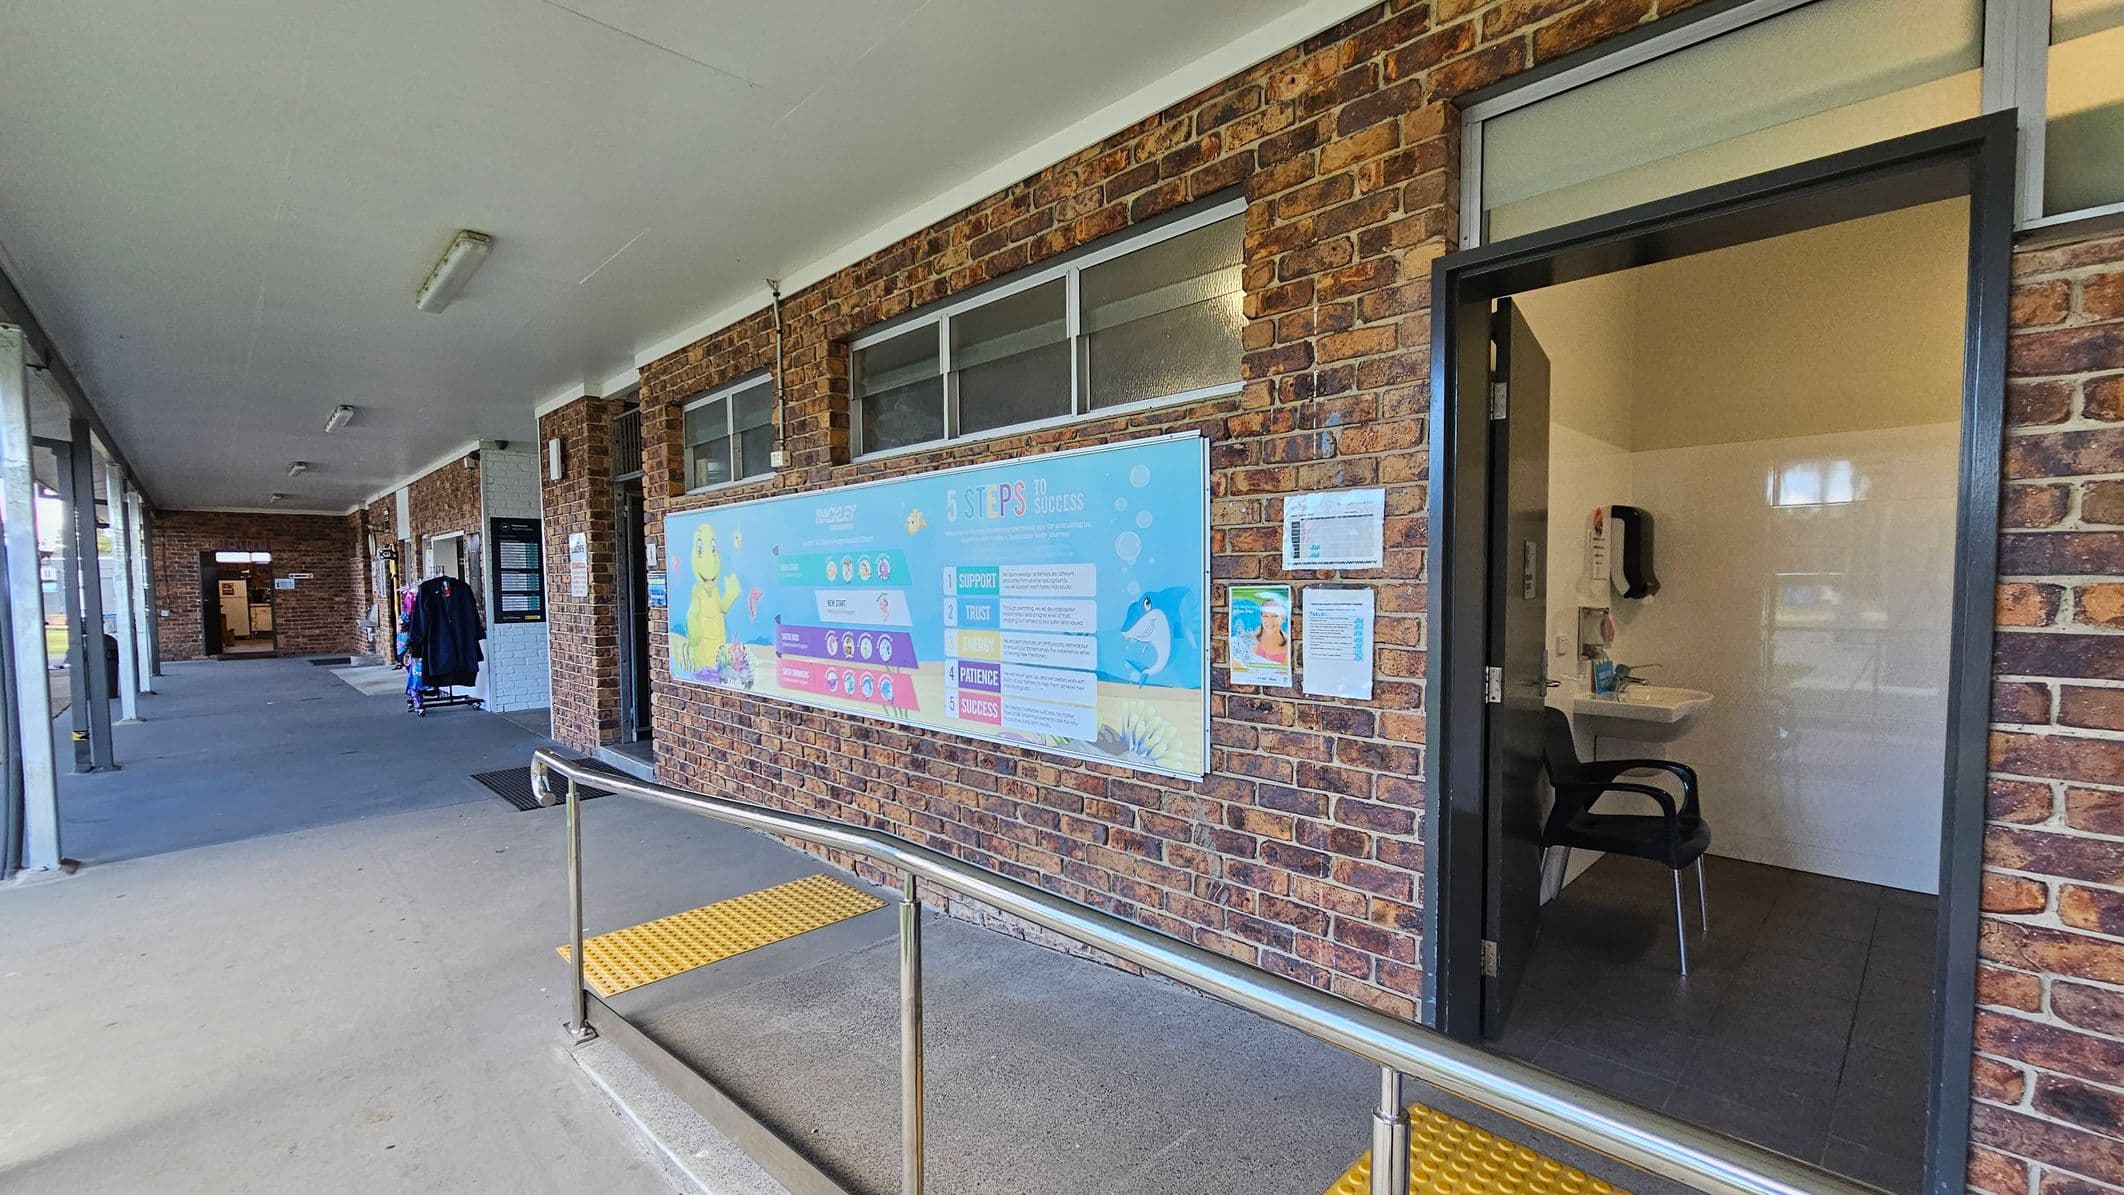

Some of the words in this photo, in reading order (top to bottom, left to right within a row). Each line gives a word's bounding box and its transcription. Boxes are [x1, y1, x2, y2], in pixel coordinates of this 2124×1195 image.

[1034, 478, 1047, 496] TO
[947, 489, 957, 522] 5
[964, 479, 1027, 521] STEPS
[1034, 493, 1085, 514] SUCCESS
[959, 573, 996, 589] SUPPORT
[948, 604, 953, 620] 2
[965, 605, 991, 621] TRUST
[948, 665, 954, 681] 4
[960, 667, 999, 686] PATIENCE
[949, 696, 955, 712] 5
[961, 698, 998, 719] SUCCESS
